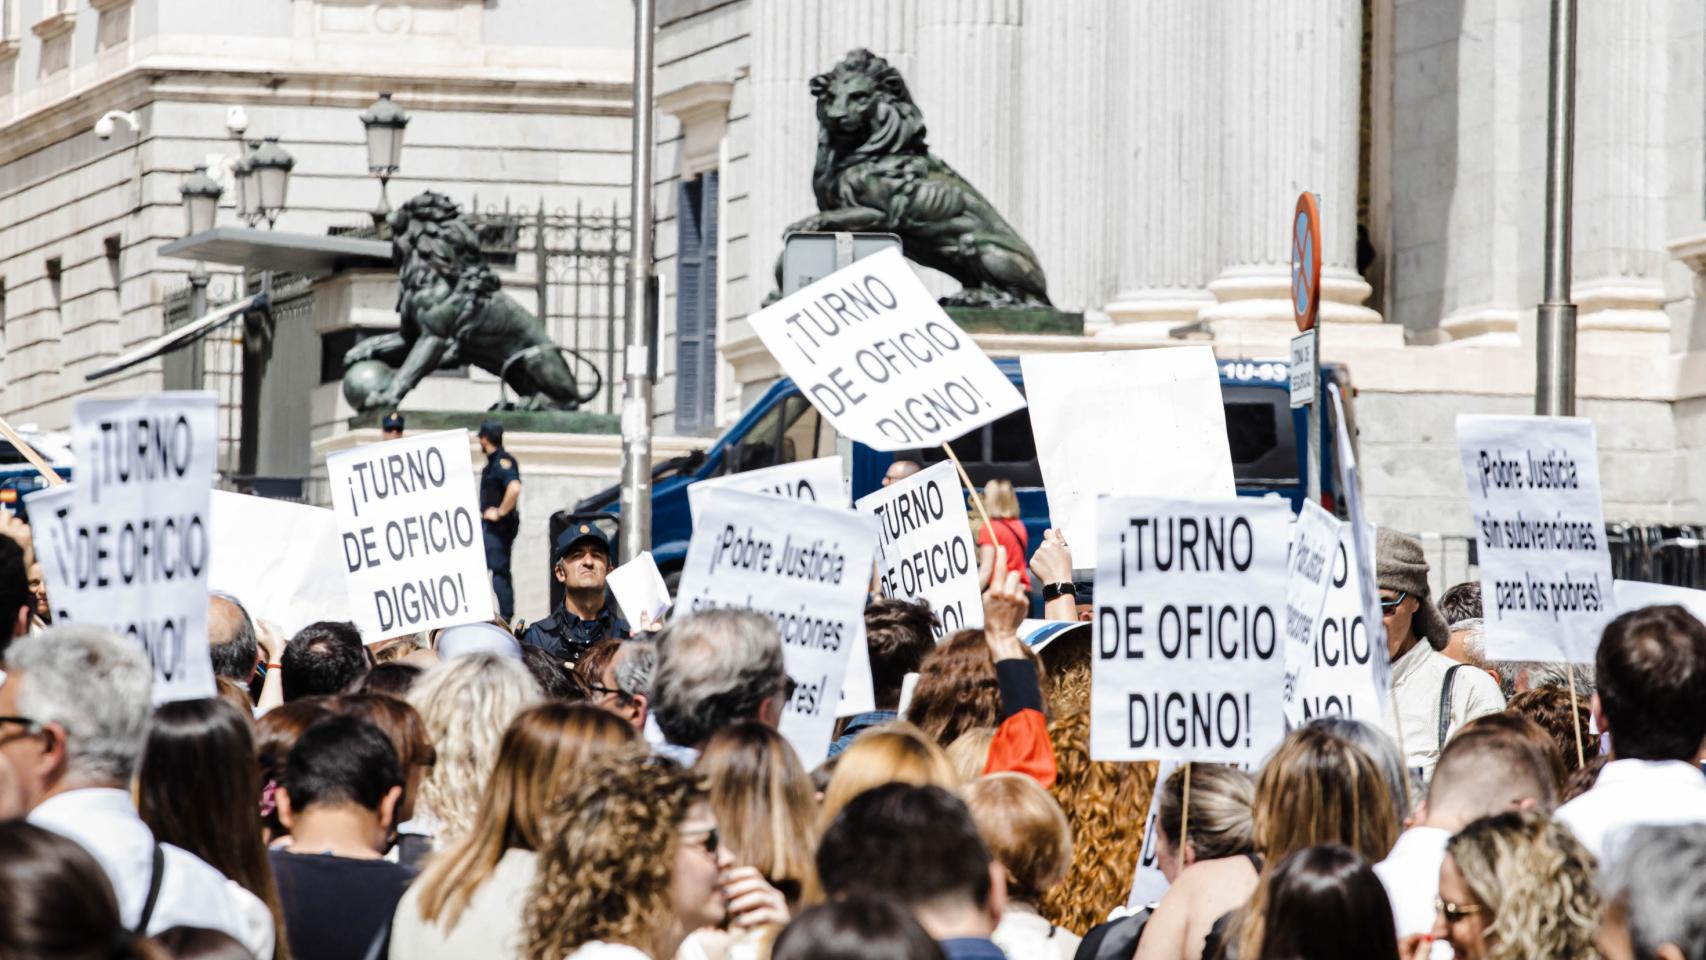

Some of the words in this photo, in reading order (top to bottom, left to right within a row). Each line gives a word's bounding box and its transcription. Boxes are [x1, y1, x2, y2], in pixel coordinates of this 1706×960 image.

[785, 274, 898, 365] ¡TURNO
[809, 366, 867, 417] DE
[855, 321, 960, 384] OFICIO
[875, 375, 992, 444] DIGNO!
[92, 414, 193, 503] ¡TURNO
[348, 446, 445, 517] ¡TURNO
[1477, 449, 1522, 498] ¡Pobre
[1526, 449, 1578, 489] Justicia
[76, 523, 108, 589] DE
[118, 515, 208, 585] OFICIO
[342, 526, 381, 573] DE
[385, 506, 474, 562] OFICIO
[709, 523, 773, 575] ¡Pobre
[775, 533, 845, 586] Justicia
[1121, 516, 1253, 587] ¡TURNO
[1482, 510, 1504, 549] sin
[1504, 510, 1597, 550] subvenciones
[901, 535, 968, 598] OFICIO
[1495, 580, 1526, 621] para
[1526, 571, 1548, 611] los
[1549, 571, 1604, 622] pobres!
[374, 572, 468, 632] DIGNO!
[1098, 605, 1144, 660] DE
[1158, 604, 1276, 661] OFICIO
[1128, 691, 1251, 749] DIGNO!
